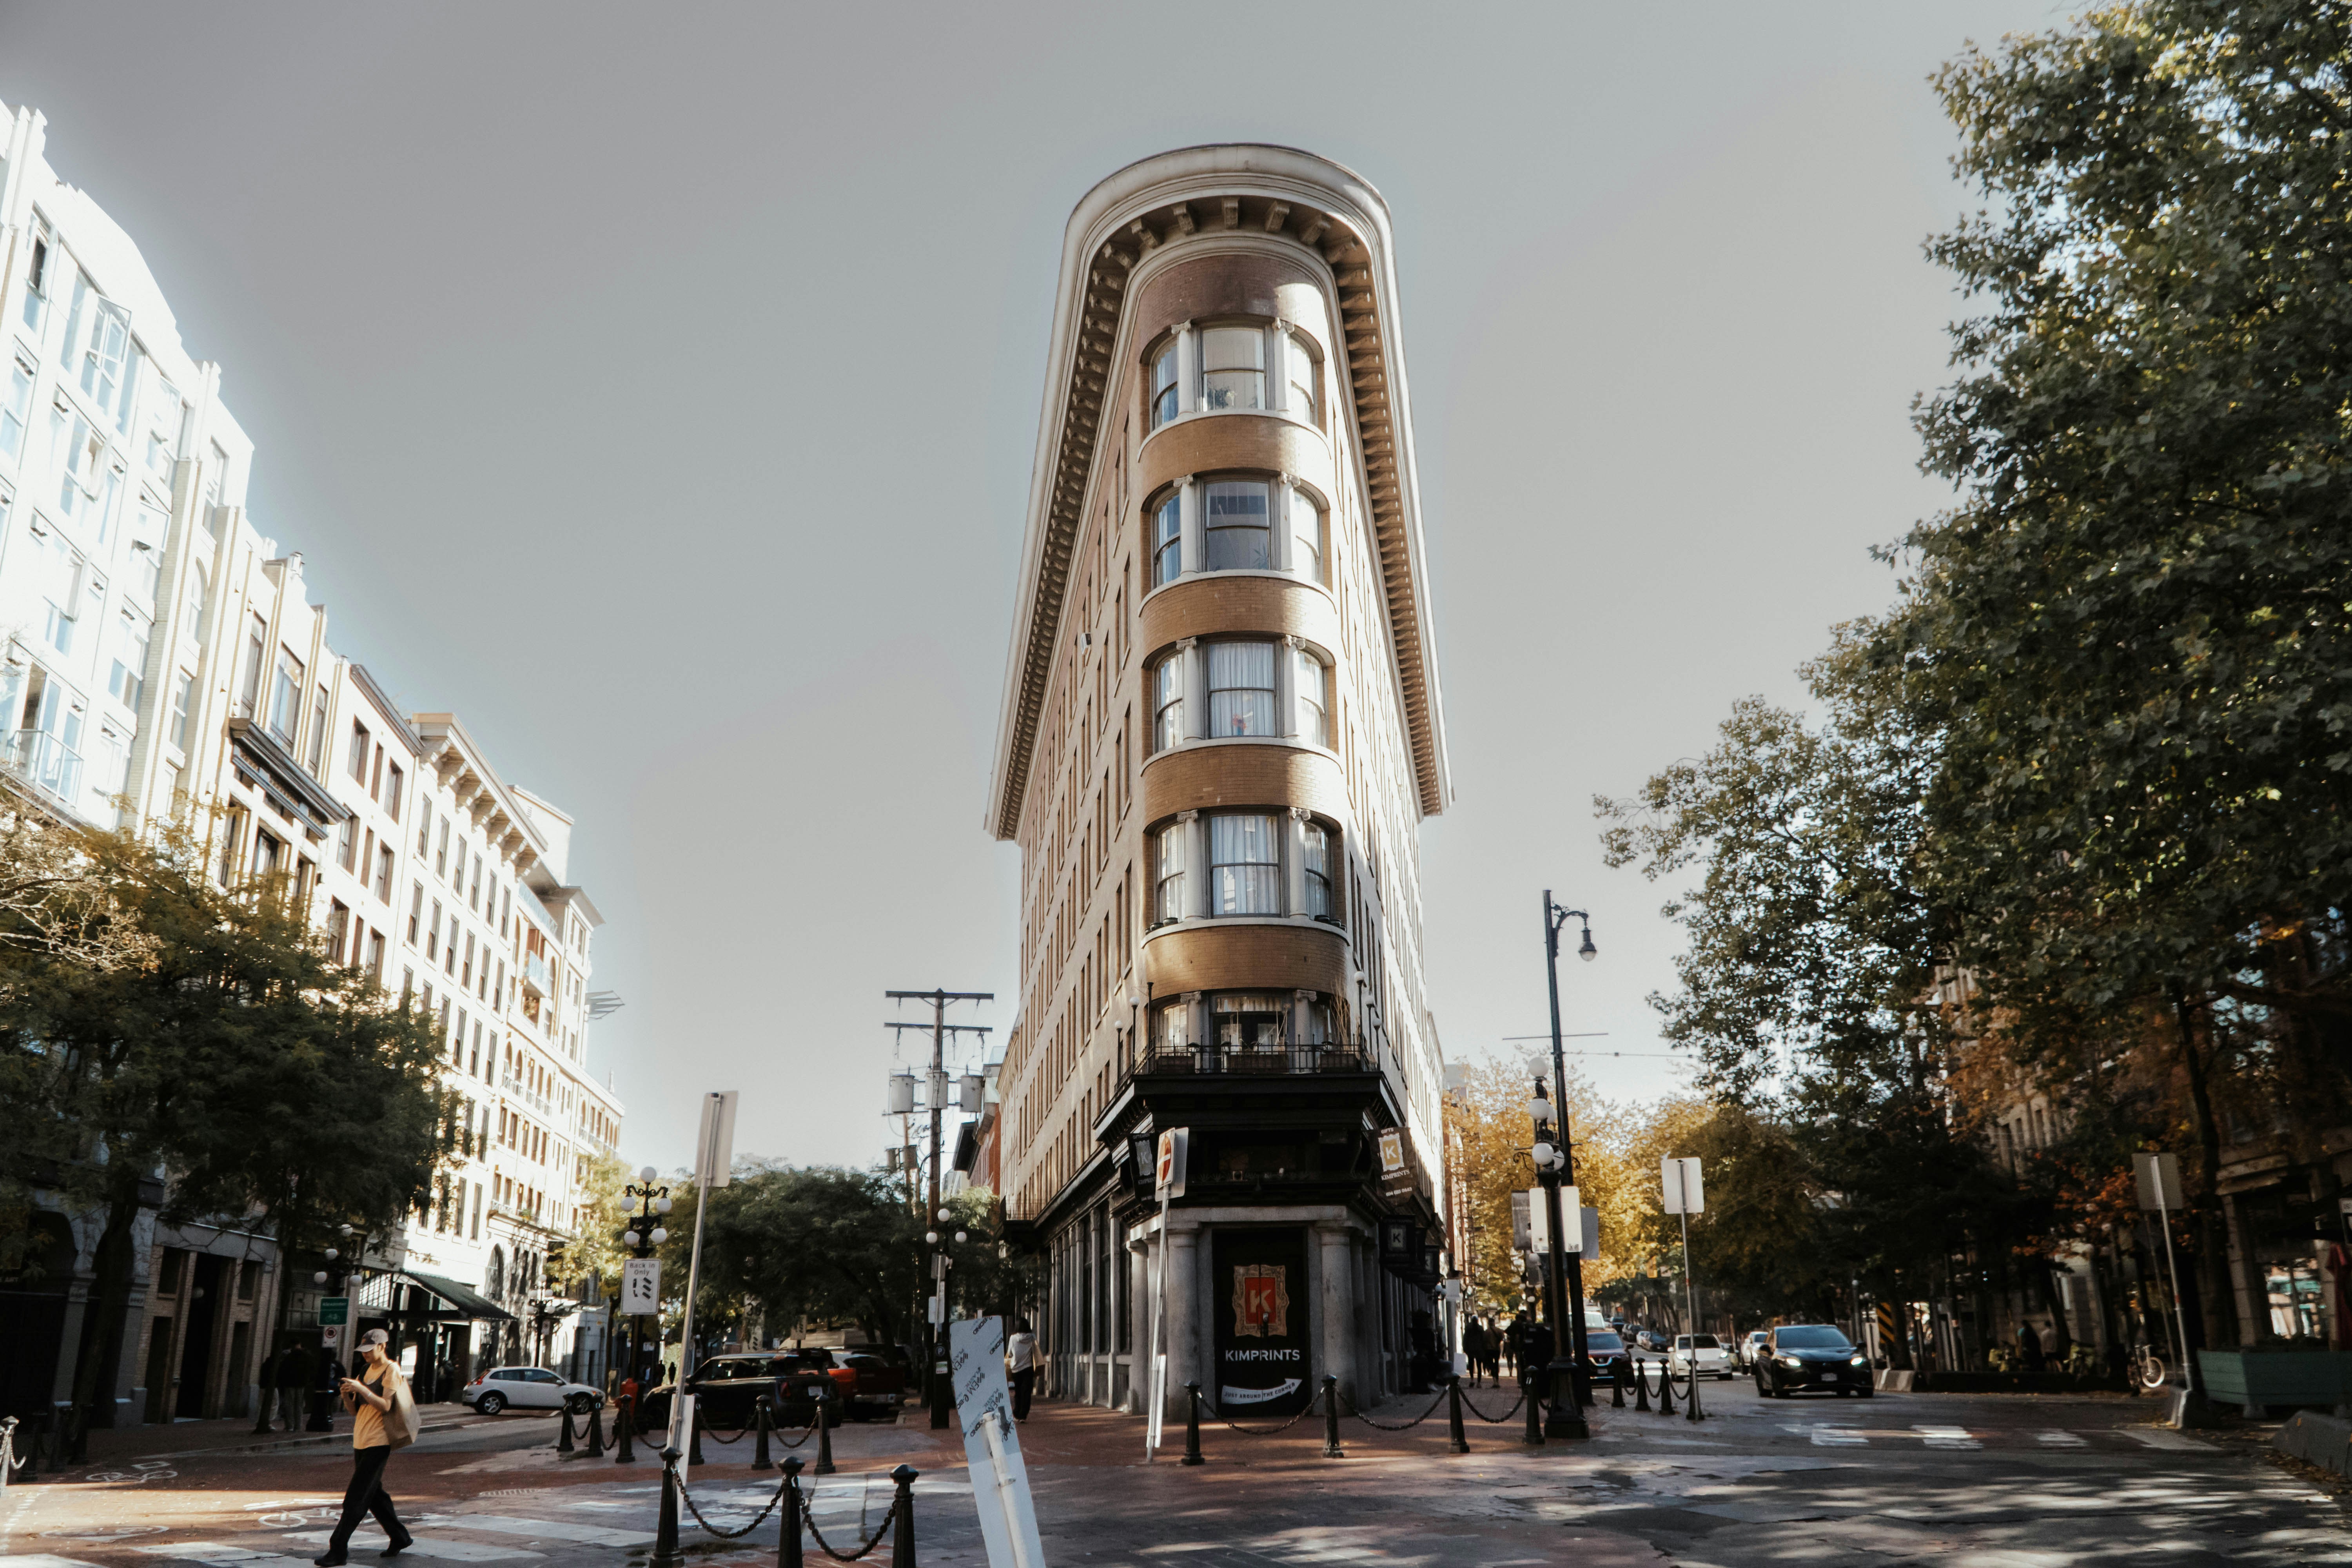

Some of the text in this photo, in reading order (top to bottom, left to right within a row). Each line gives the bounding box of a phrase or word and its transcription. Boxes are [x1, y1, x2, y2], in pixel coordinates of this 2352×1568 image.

[1141, 1152, 1149, 1164] K
[1385, 1145, 1397, 1159] K
[1138, 1177, 1156, 1185] KIMPRINT
[1381, 1170, 1410, 1181] KIMPRINTS
[1393, 1233, 1400, 1242] K
[1249, 1289, 1271, 1313] K
[973, 1317, 992, 1334] -BOND
[989, 1337, 1003, 1355] BOND
[1225, 1349, 1300, 1361] KIMPRINTS
[1275, 1382, 1295, 1394] CORNER
